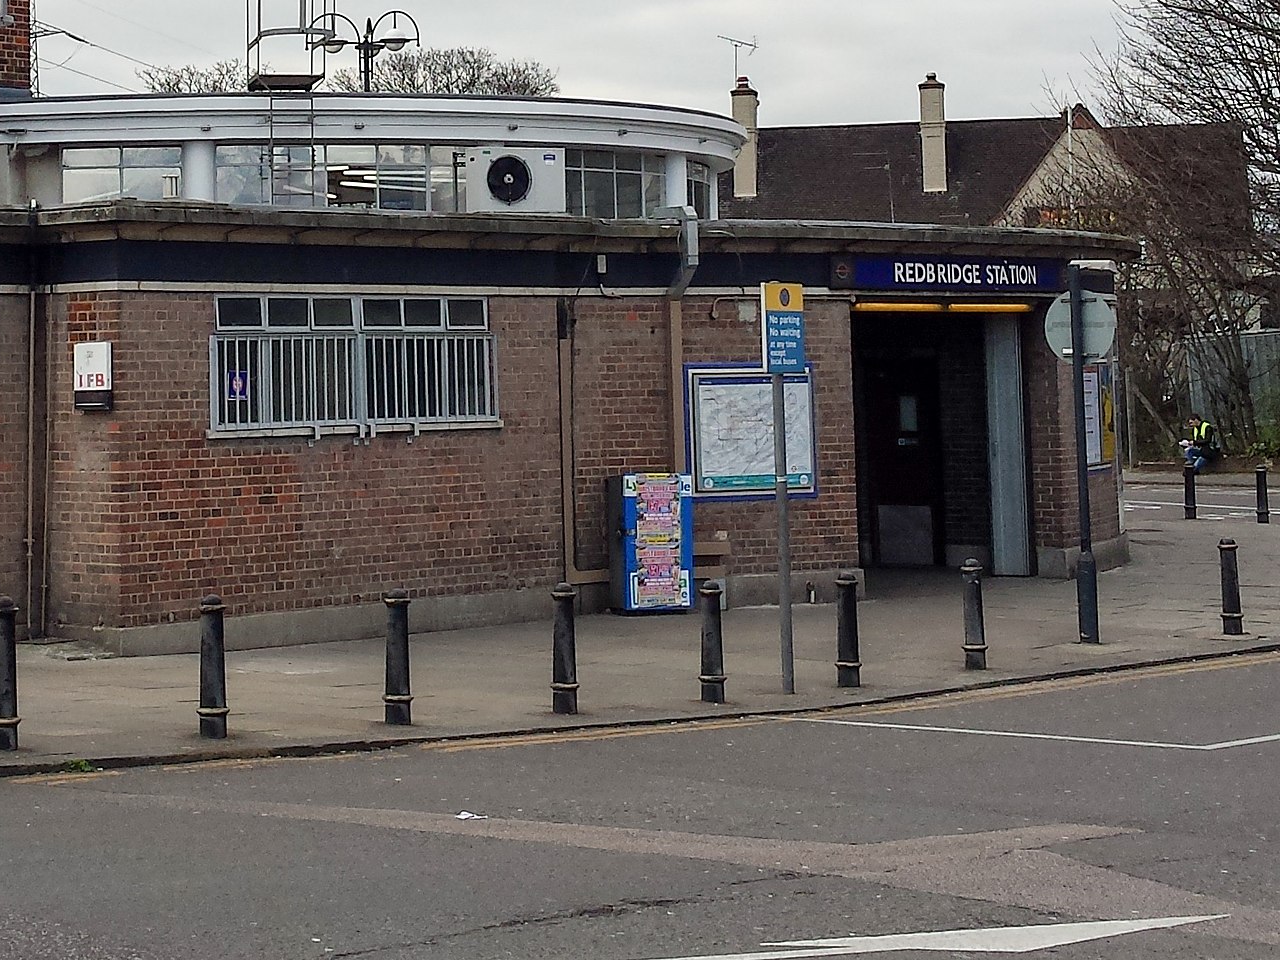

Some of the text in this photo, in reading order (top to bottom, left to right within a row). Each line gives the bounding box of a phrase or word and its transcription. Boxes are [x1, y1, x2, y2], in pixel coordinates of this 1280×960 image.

[894, 262, 1037, 285] REDBRIDGE STATION
[769, 315, 800, 326] No parking
[770, 327, 800, 338] No waiting
[776, 341, 784, 349] any
[79, 374, 105, 387] IFB
